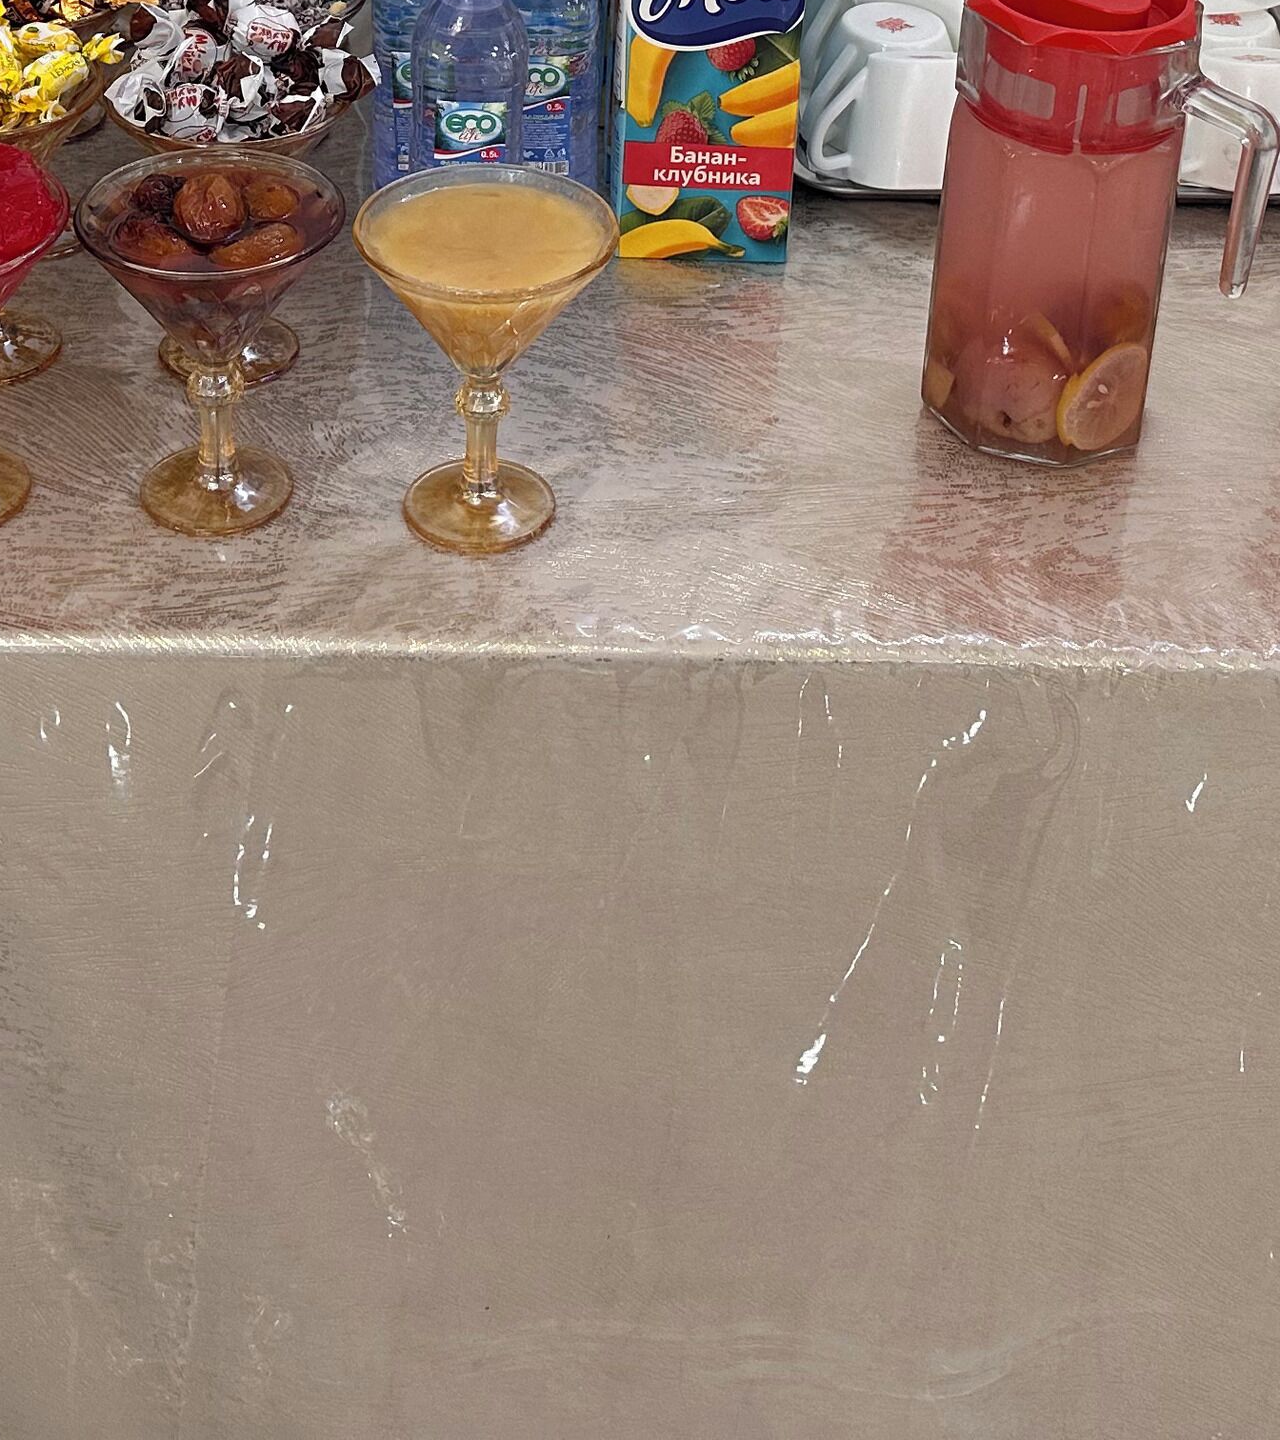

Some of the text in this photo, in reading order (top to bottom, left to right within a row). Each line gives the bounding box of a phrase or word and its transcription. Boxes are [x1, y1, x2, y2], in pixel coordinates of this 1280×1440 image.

[528, 67, 561, 87] co
[445, 113, 497, 134] eco
[670, 146, 747, 166] Банан-
[653, 165, 761, 187] клубника
